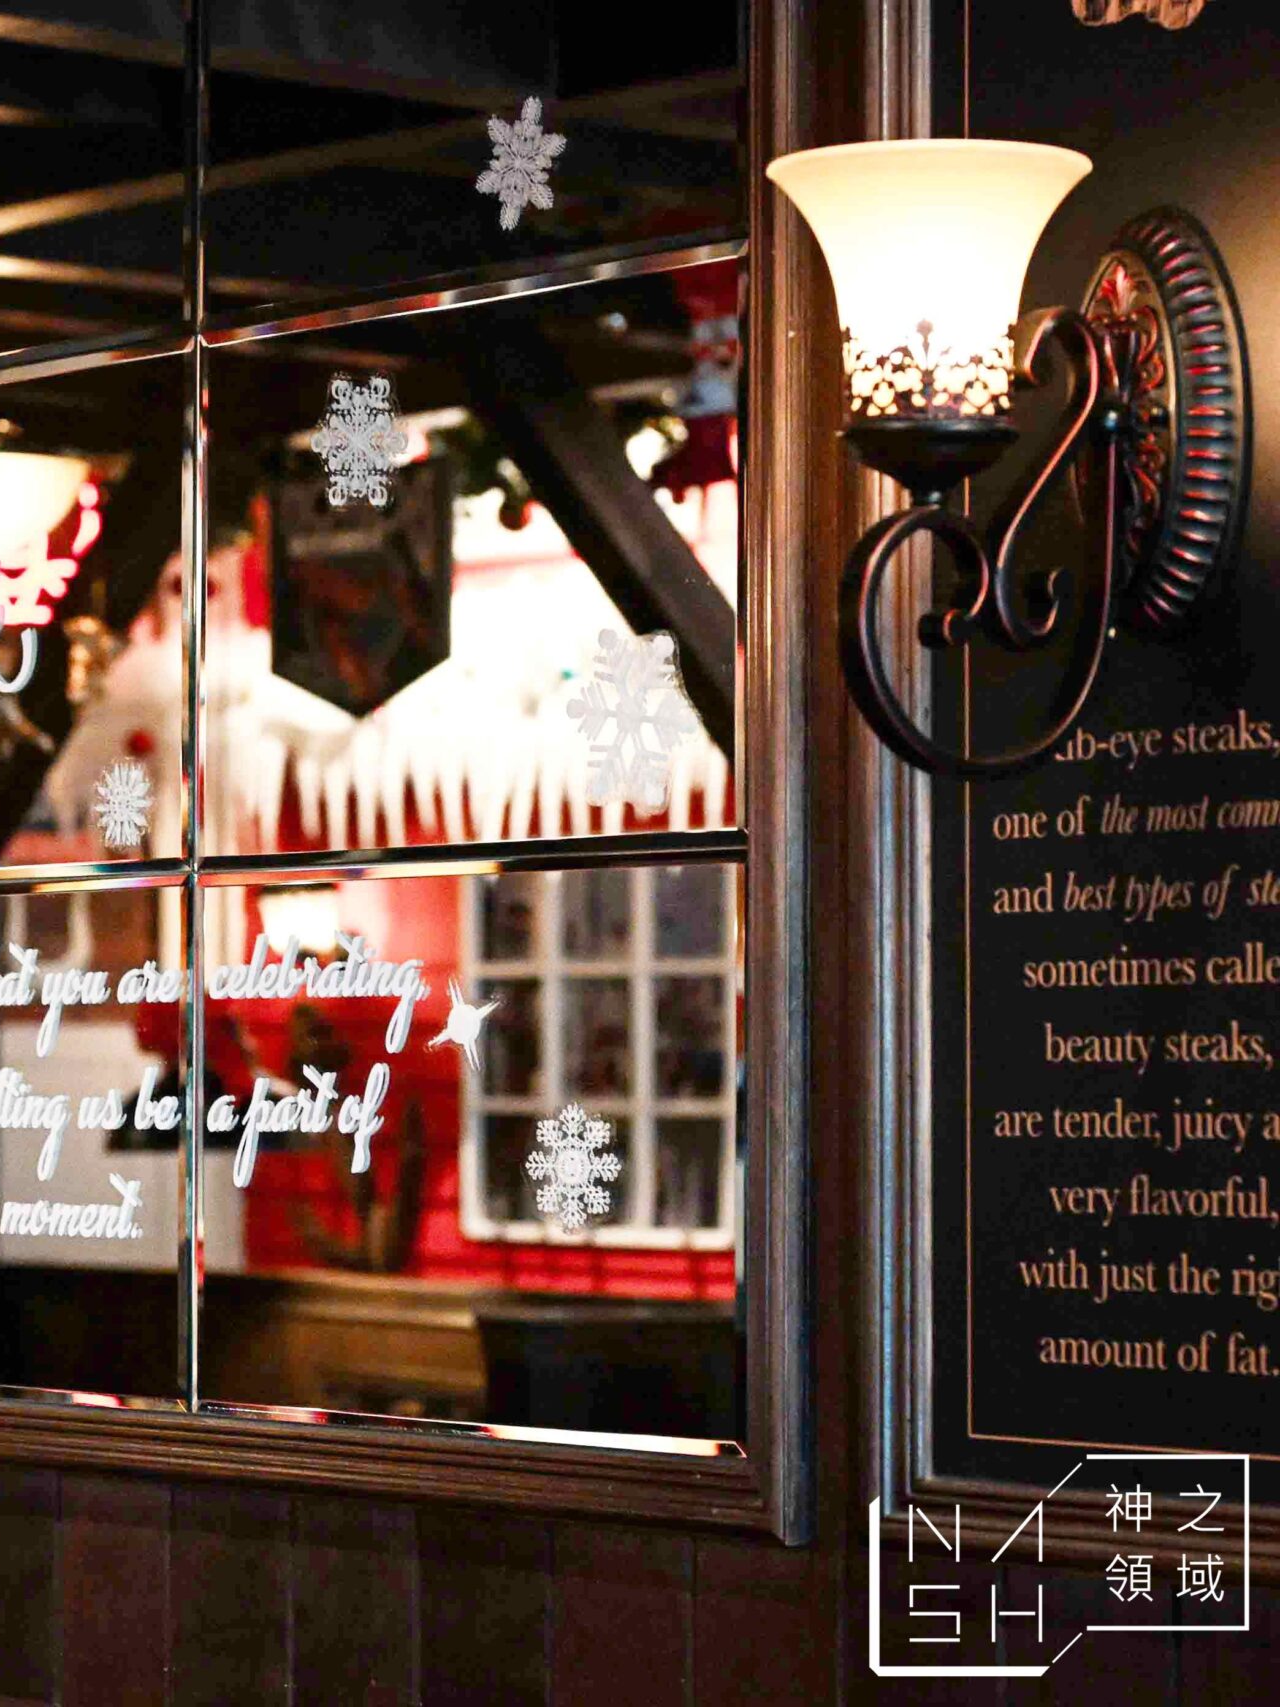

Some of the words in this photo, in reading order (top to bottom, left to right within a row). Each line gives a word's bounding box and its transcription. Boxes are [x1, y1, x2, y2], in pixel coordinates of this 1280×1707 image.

[992, 810, 1048, 841] one
[1056, 794, 1091, 837] of
[1100, 792, 1139, 835] the
[1146, 795, 1210, 833] most
[992, 871, 1054, 914] and
[1063, 870, 1116, 912] best
[1124, 874, 1194, 923] types
[1202, 863, 1241, 920] of
[1023, 944, 1198, 989] sometimes
[36, 968, 111, 1058] you
[116, 960, 183, 1004] are
[1045, 1022, 1155, 1075] beauty
[1164, 1020, 1274, 1069] steaks,
[77, 1088, 127, 1130] us
[134, 1066, 182, 1130] be
[207, 1094, 239, 1132] a
[233, 1063, 338, 1188] part
[338, 1063, 390, 1173] of
[994, 1108, 1044, 1139] are
[1052, 1098, 1162, 1146] tender,
[1166, 1098, 1254, 1153] juicy
[0, 1173, 144, 1240] moment.
[1049, 1183, 1118, 1227] very
[1130, 1173, 1279, 1227] flavorful,
[1020, 1246, 1089, 1291] with
[1095, 1249, 1157, 1304] just
[1169, 1252, 1220, 1296] the
[1039, 1336, 1168, 1371] amount
[1177, 1330, 1216, 1373] of
[1229, 1332, 1280, 1377] fat.
